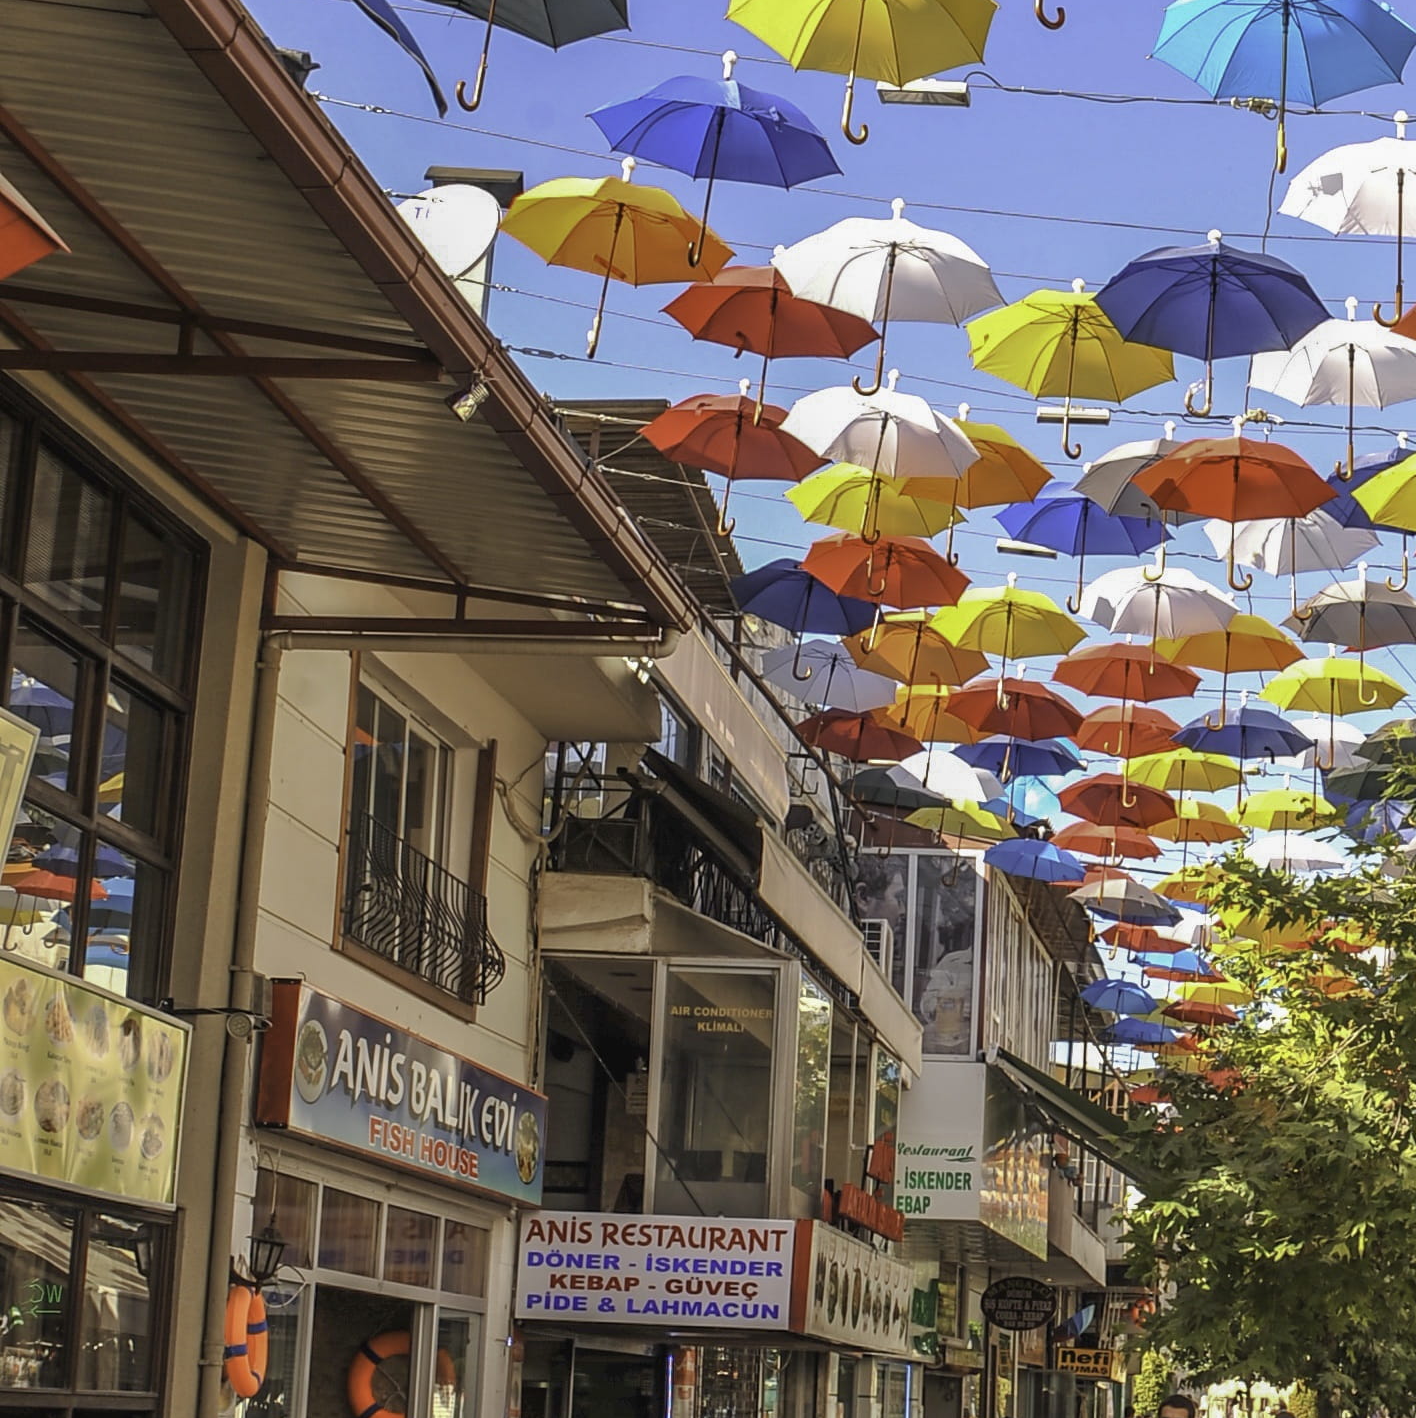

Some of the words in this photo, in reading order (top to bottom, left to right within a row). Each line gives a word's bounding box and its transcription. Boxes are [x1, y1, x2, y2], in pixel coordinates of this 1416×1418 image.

[671, 1006, 691, 1016] AIR
[694, 1007, 774, 1019] CONDITIONER
[330, 1029, 406, 1106] ANİS
[411, 1060, 479, 1138] BALIK
[369, 1115, 416, 1158] FISH
[420, 1134, 479, 1180] HOUSE
[904, 1167, 972, 1190] İSKENDER
[525, 1216, 593, 1246] ANİS
[601, 1222, 787, 1254] RESTAURANT
[526, 1250, 621, 1271] DÖNER
[645, 1253, 783, 1278] İSKENDER
[549, 1273, 640, 1293] KEBAP
[664, 1276, 759, 1301] GÜVEÇ
[526, 1291, 588, 1312] PİDE
[597, 1297, 616, 1313] &
[626, 1298, 780, 1320] LAHMACUN
[1061, 1350, 1110, 1366] nefi
